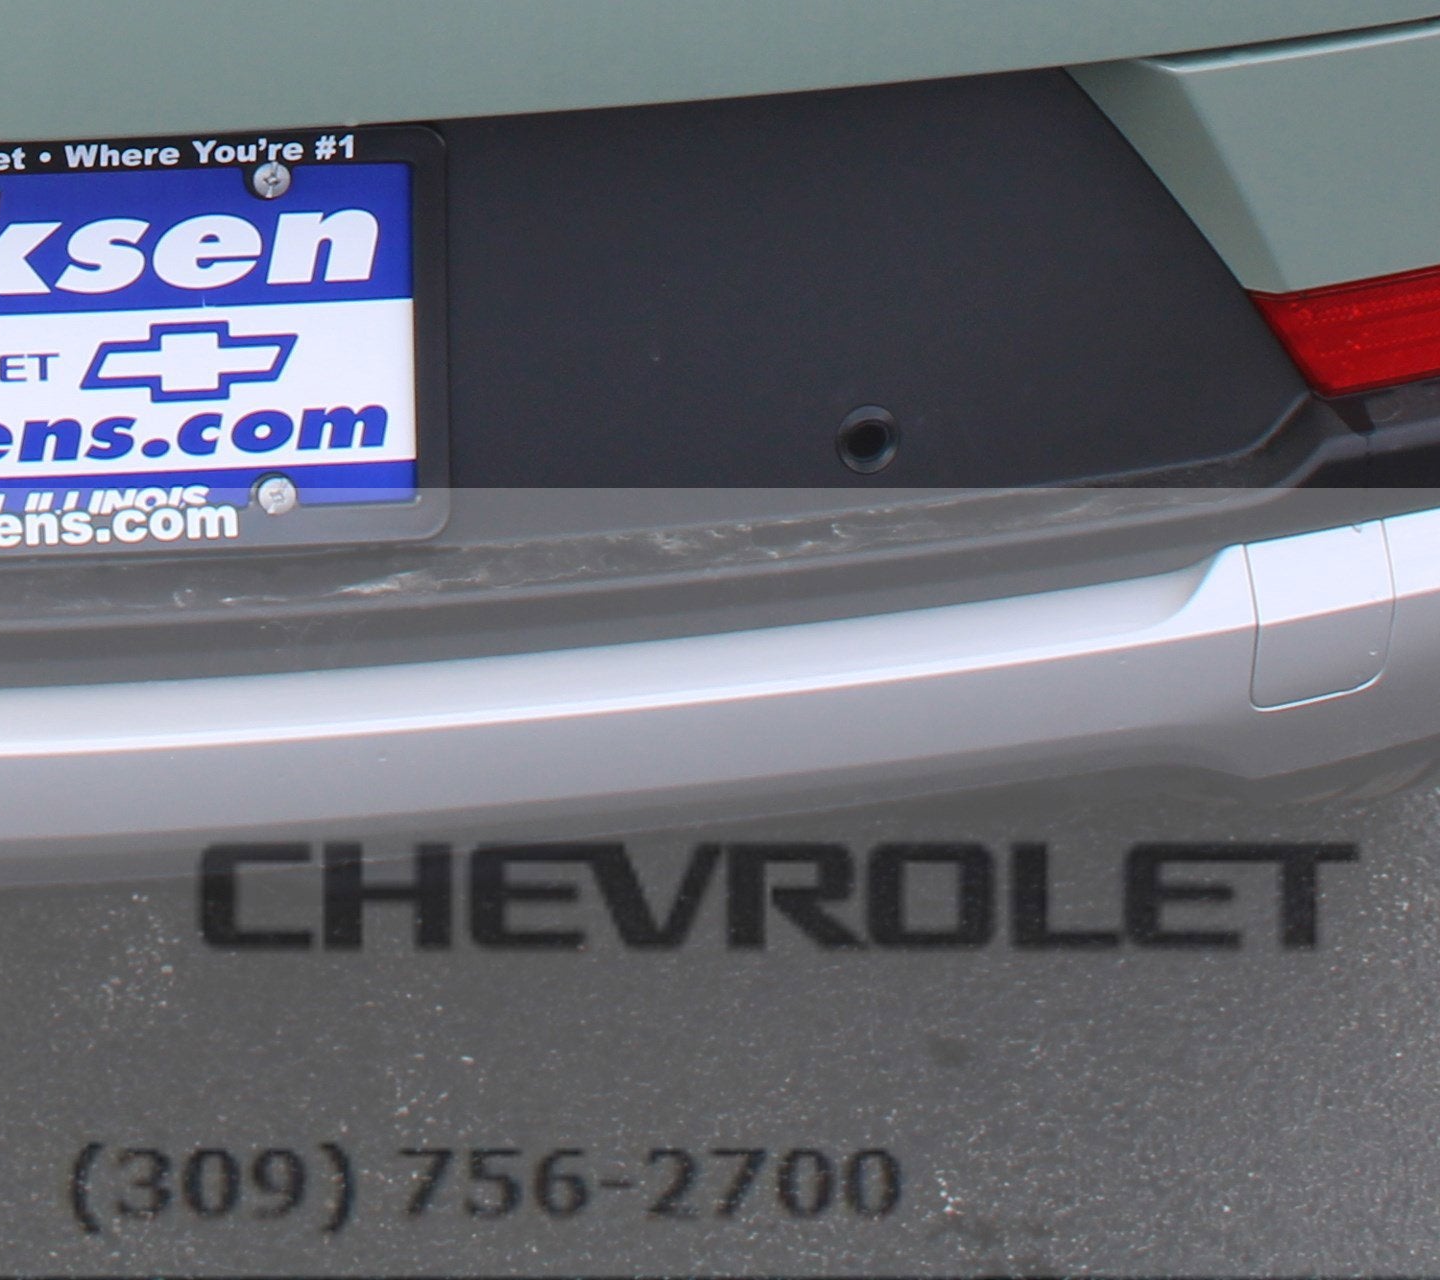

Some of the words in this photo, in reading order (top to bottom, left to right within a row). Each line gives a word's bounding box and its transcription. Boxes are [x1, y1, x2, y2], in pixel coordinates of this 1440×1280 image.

[64, 143, 180, 169] Where
[192, 139, 304, 166] You're
[315, 135, 355, 161] #1
